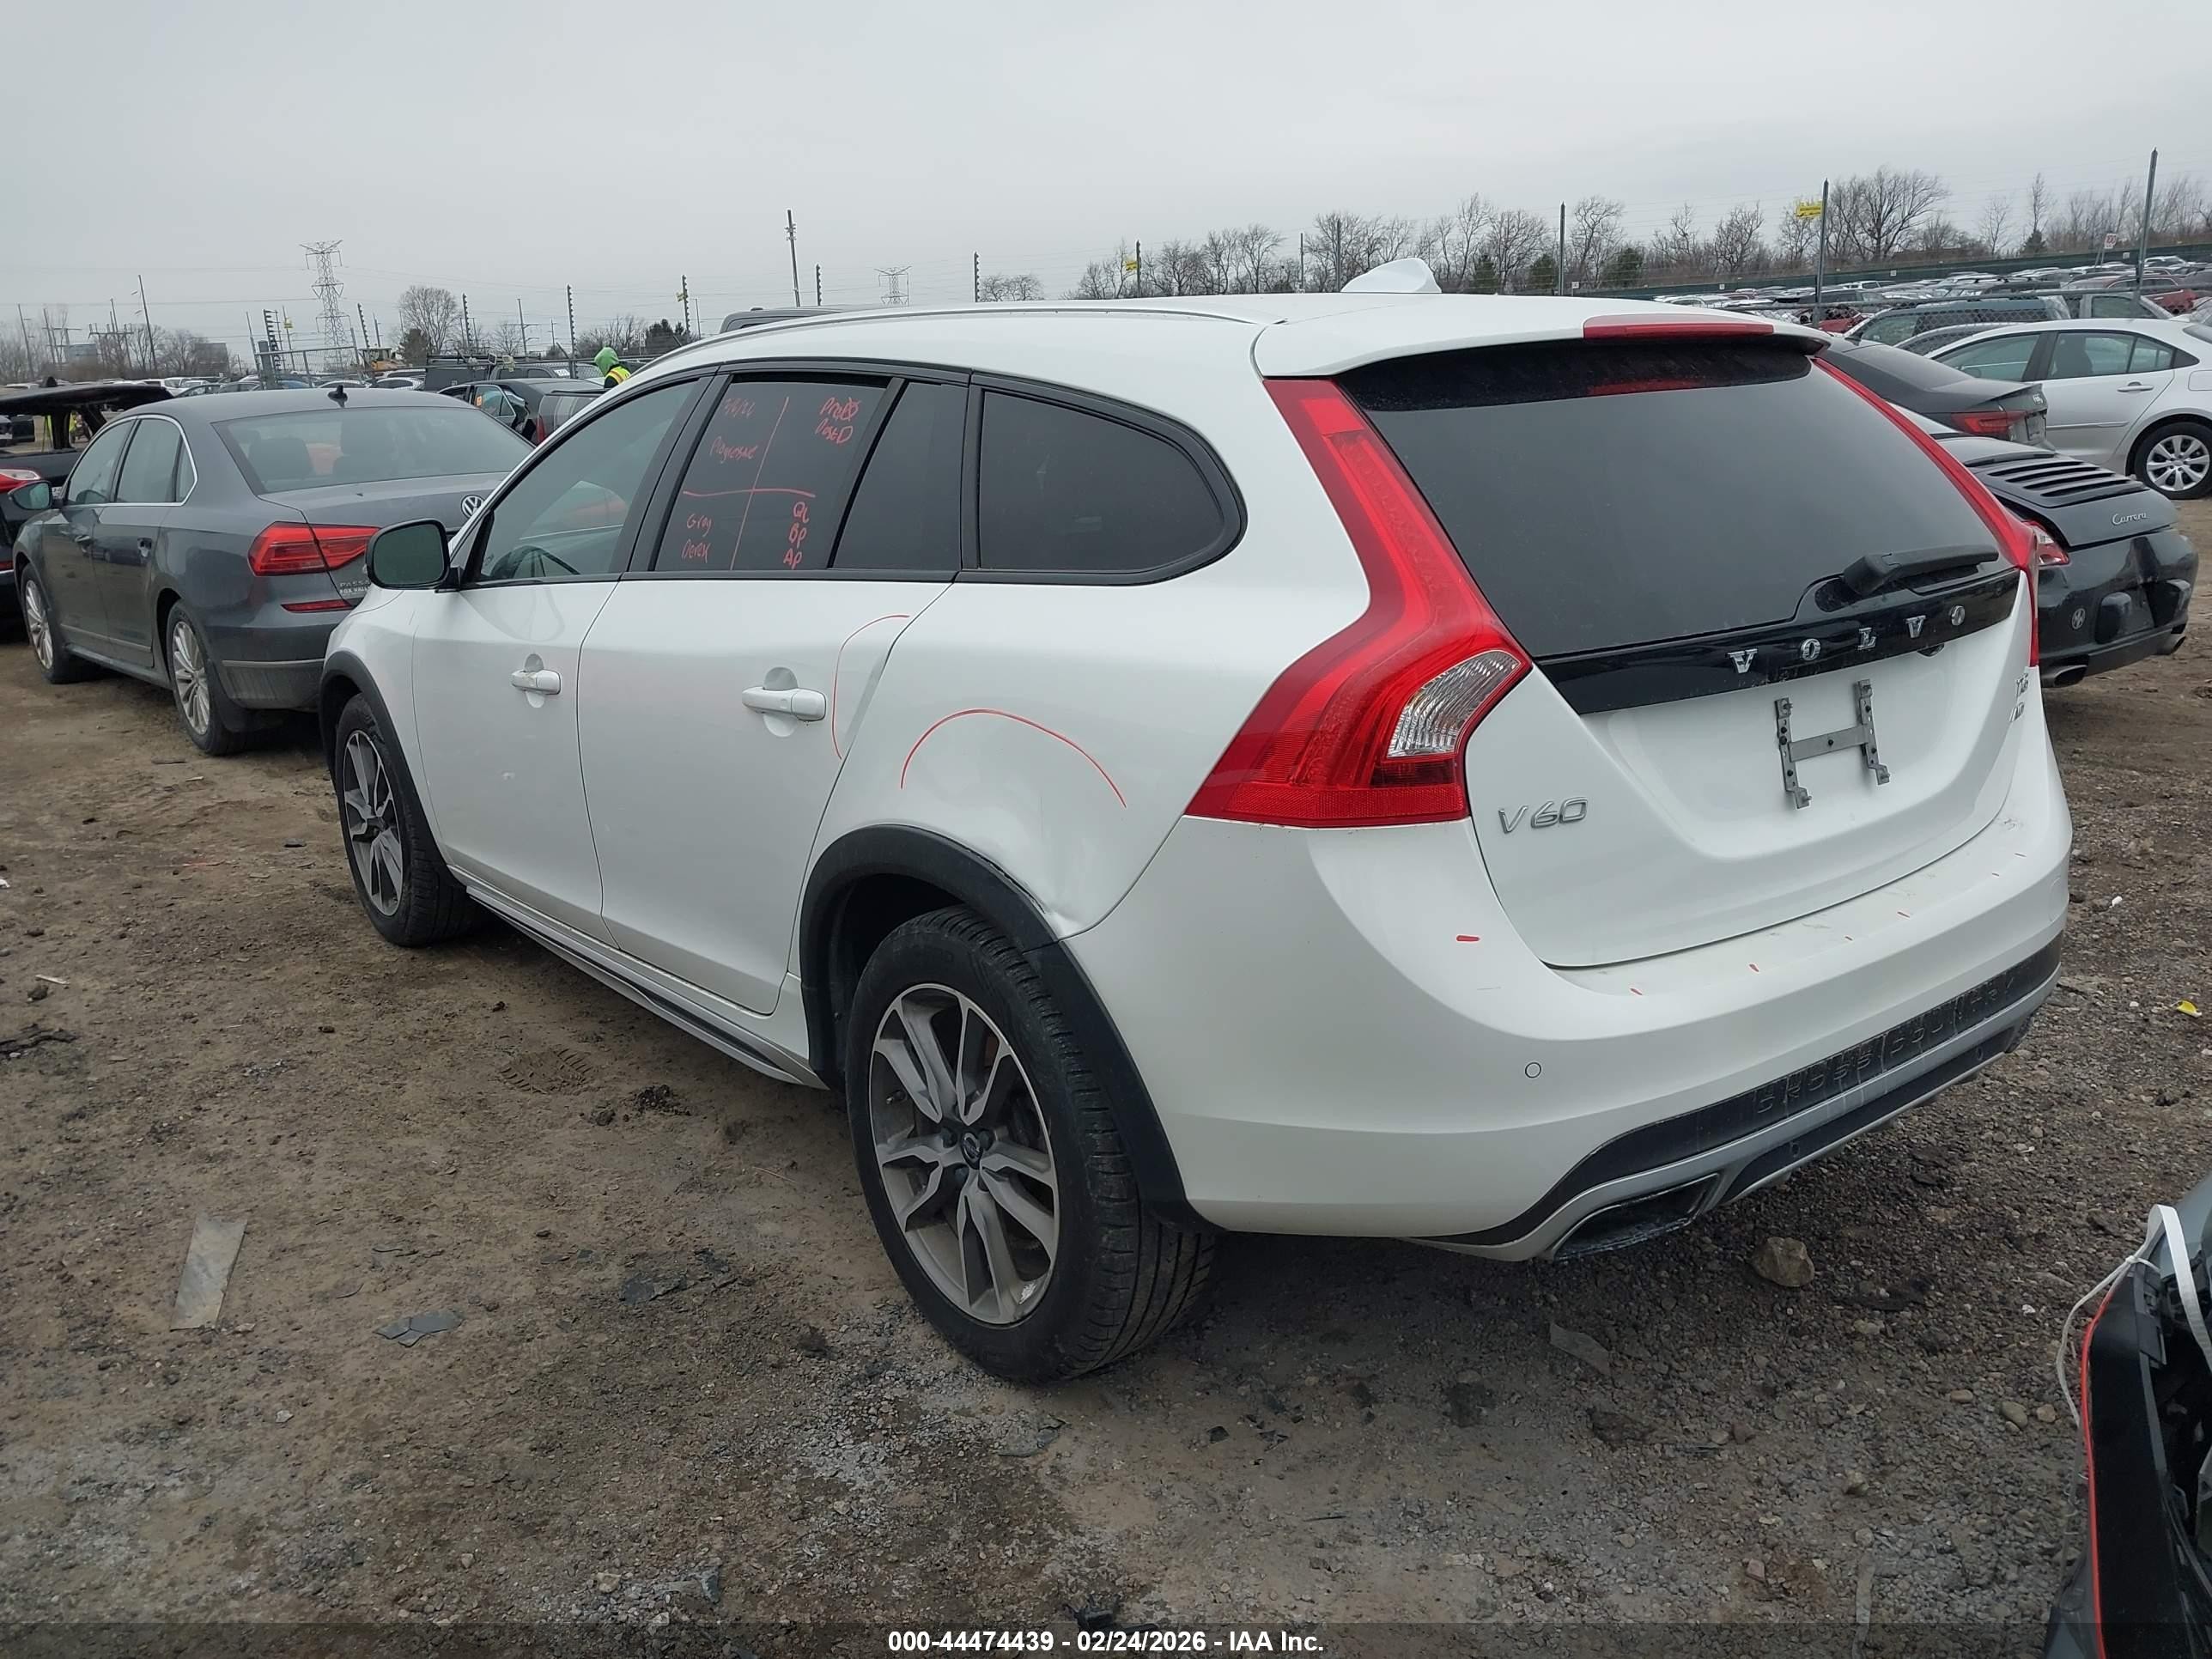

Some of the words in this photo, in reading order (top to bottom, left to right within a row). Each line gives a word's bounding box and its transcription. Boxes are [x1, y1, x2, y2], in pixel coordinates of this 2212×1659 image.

[2112, 513, 2149, 526] Carrera
[1726, 605, 1966, 674] VOLVO
[1498, 796, 1589, 835] V60
